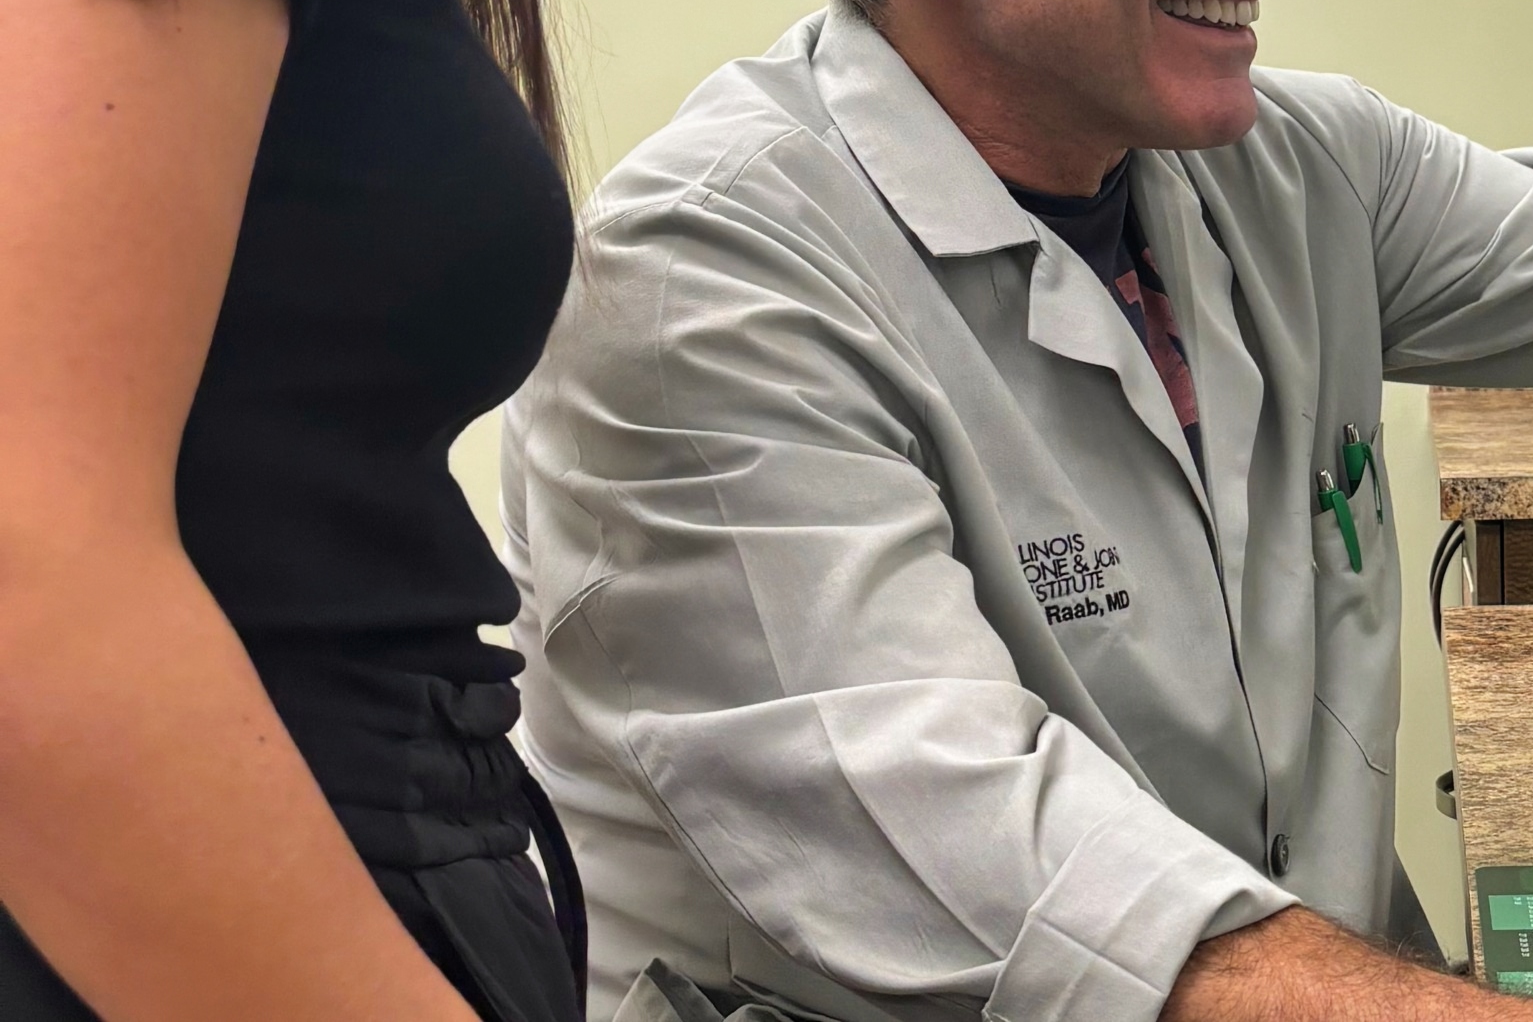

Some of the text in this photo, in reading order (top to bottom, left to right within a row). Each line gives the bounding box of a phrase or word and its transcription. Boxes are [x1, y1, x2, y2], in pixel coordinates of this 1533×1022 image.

[1018, 533, 1085, 565] LINOIS
[1023, 558, 1069, 583] ONE
[1074, 554, 1089, 573] &
[1033, 570, 1105, 602] STITUTE
[1045, 590, 1130, 626] Raab, MD
